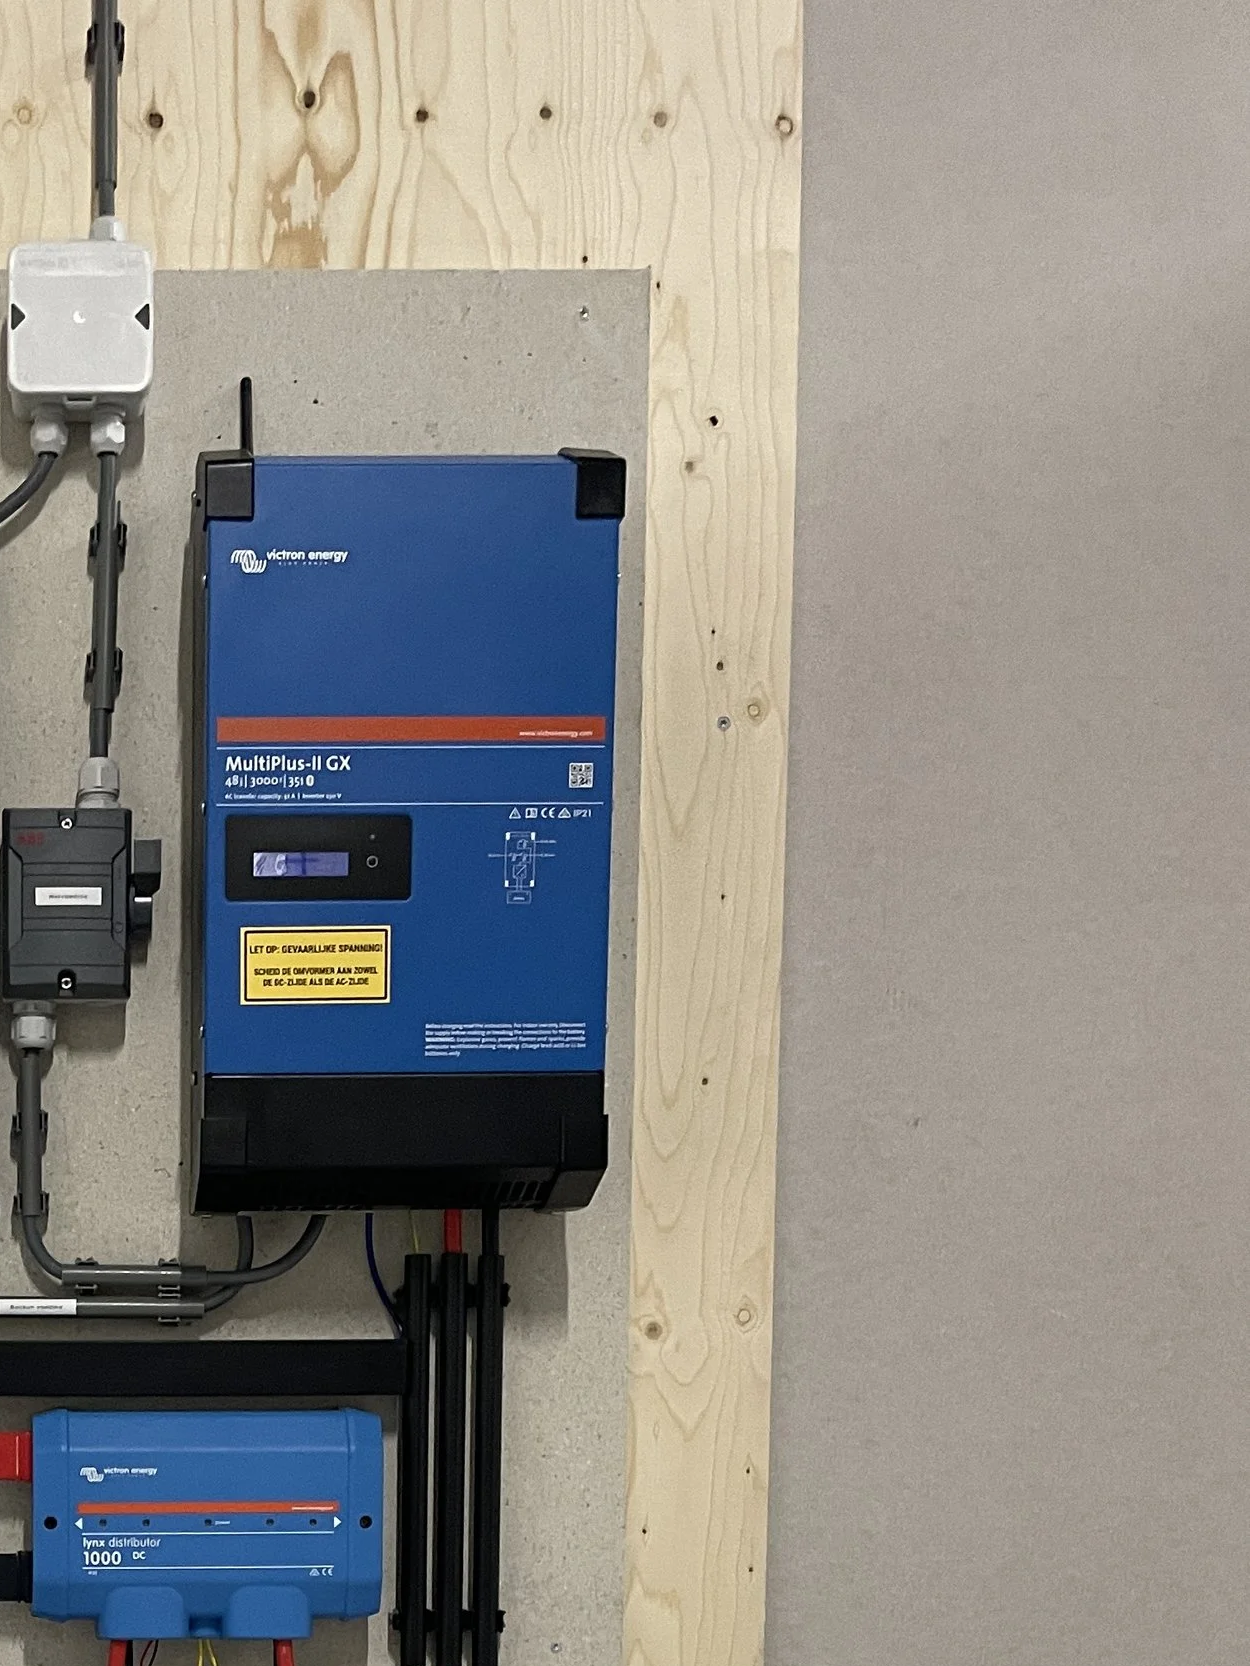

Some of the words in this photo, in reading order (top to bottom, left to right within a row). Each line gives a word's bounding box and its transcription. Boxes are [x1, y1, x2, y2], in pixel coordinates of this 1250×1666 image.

[266, 548, 305, 560] victron
[308, 551, 348, 562] energy
[225, 754, 322, 771] MultiPlus-II
[325, 755, 351, 771] GX
[249, 945, 264, 954] LET
[266, 945, 280, 954] OP:
[281, 944, 336, 954] GEVAARLIJKE
[338, 944, 384, 953] SPANNING!
[253, 968, 281, 976] SCHEID
[282, 967, 292, 976] DE
[293, 967, 335, 976] OMVORMER
[337, 966, 352, 975] AAN
[353, 966, 378, 975] ZOWEL
[309, 977, 323, 986] ALS
[82, 1537, 105, 1550] lynx
[108, 1536, 162, 1548] distributor
[83, 1550, 122, 1566] 1000
[132, 1551, 147, 1560] DC
